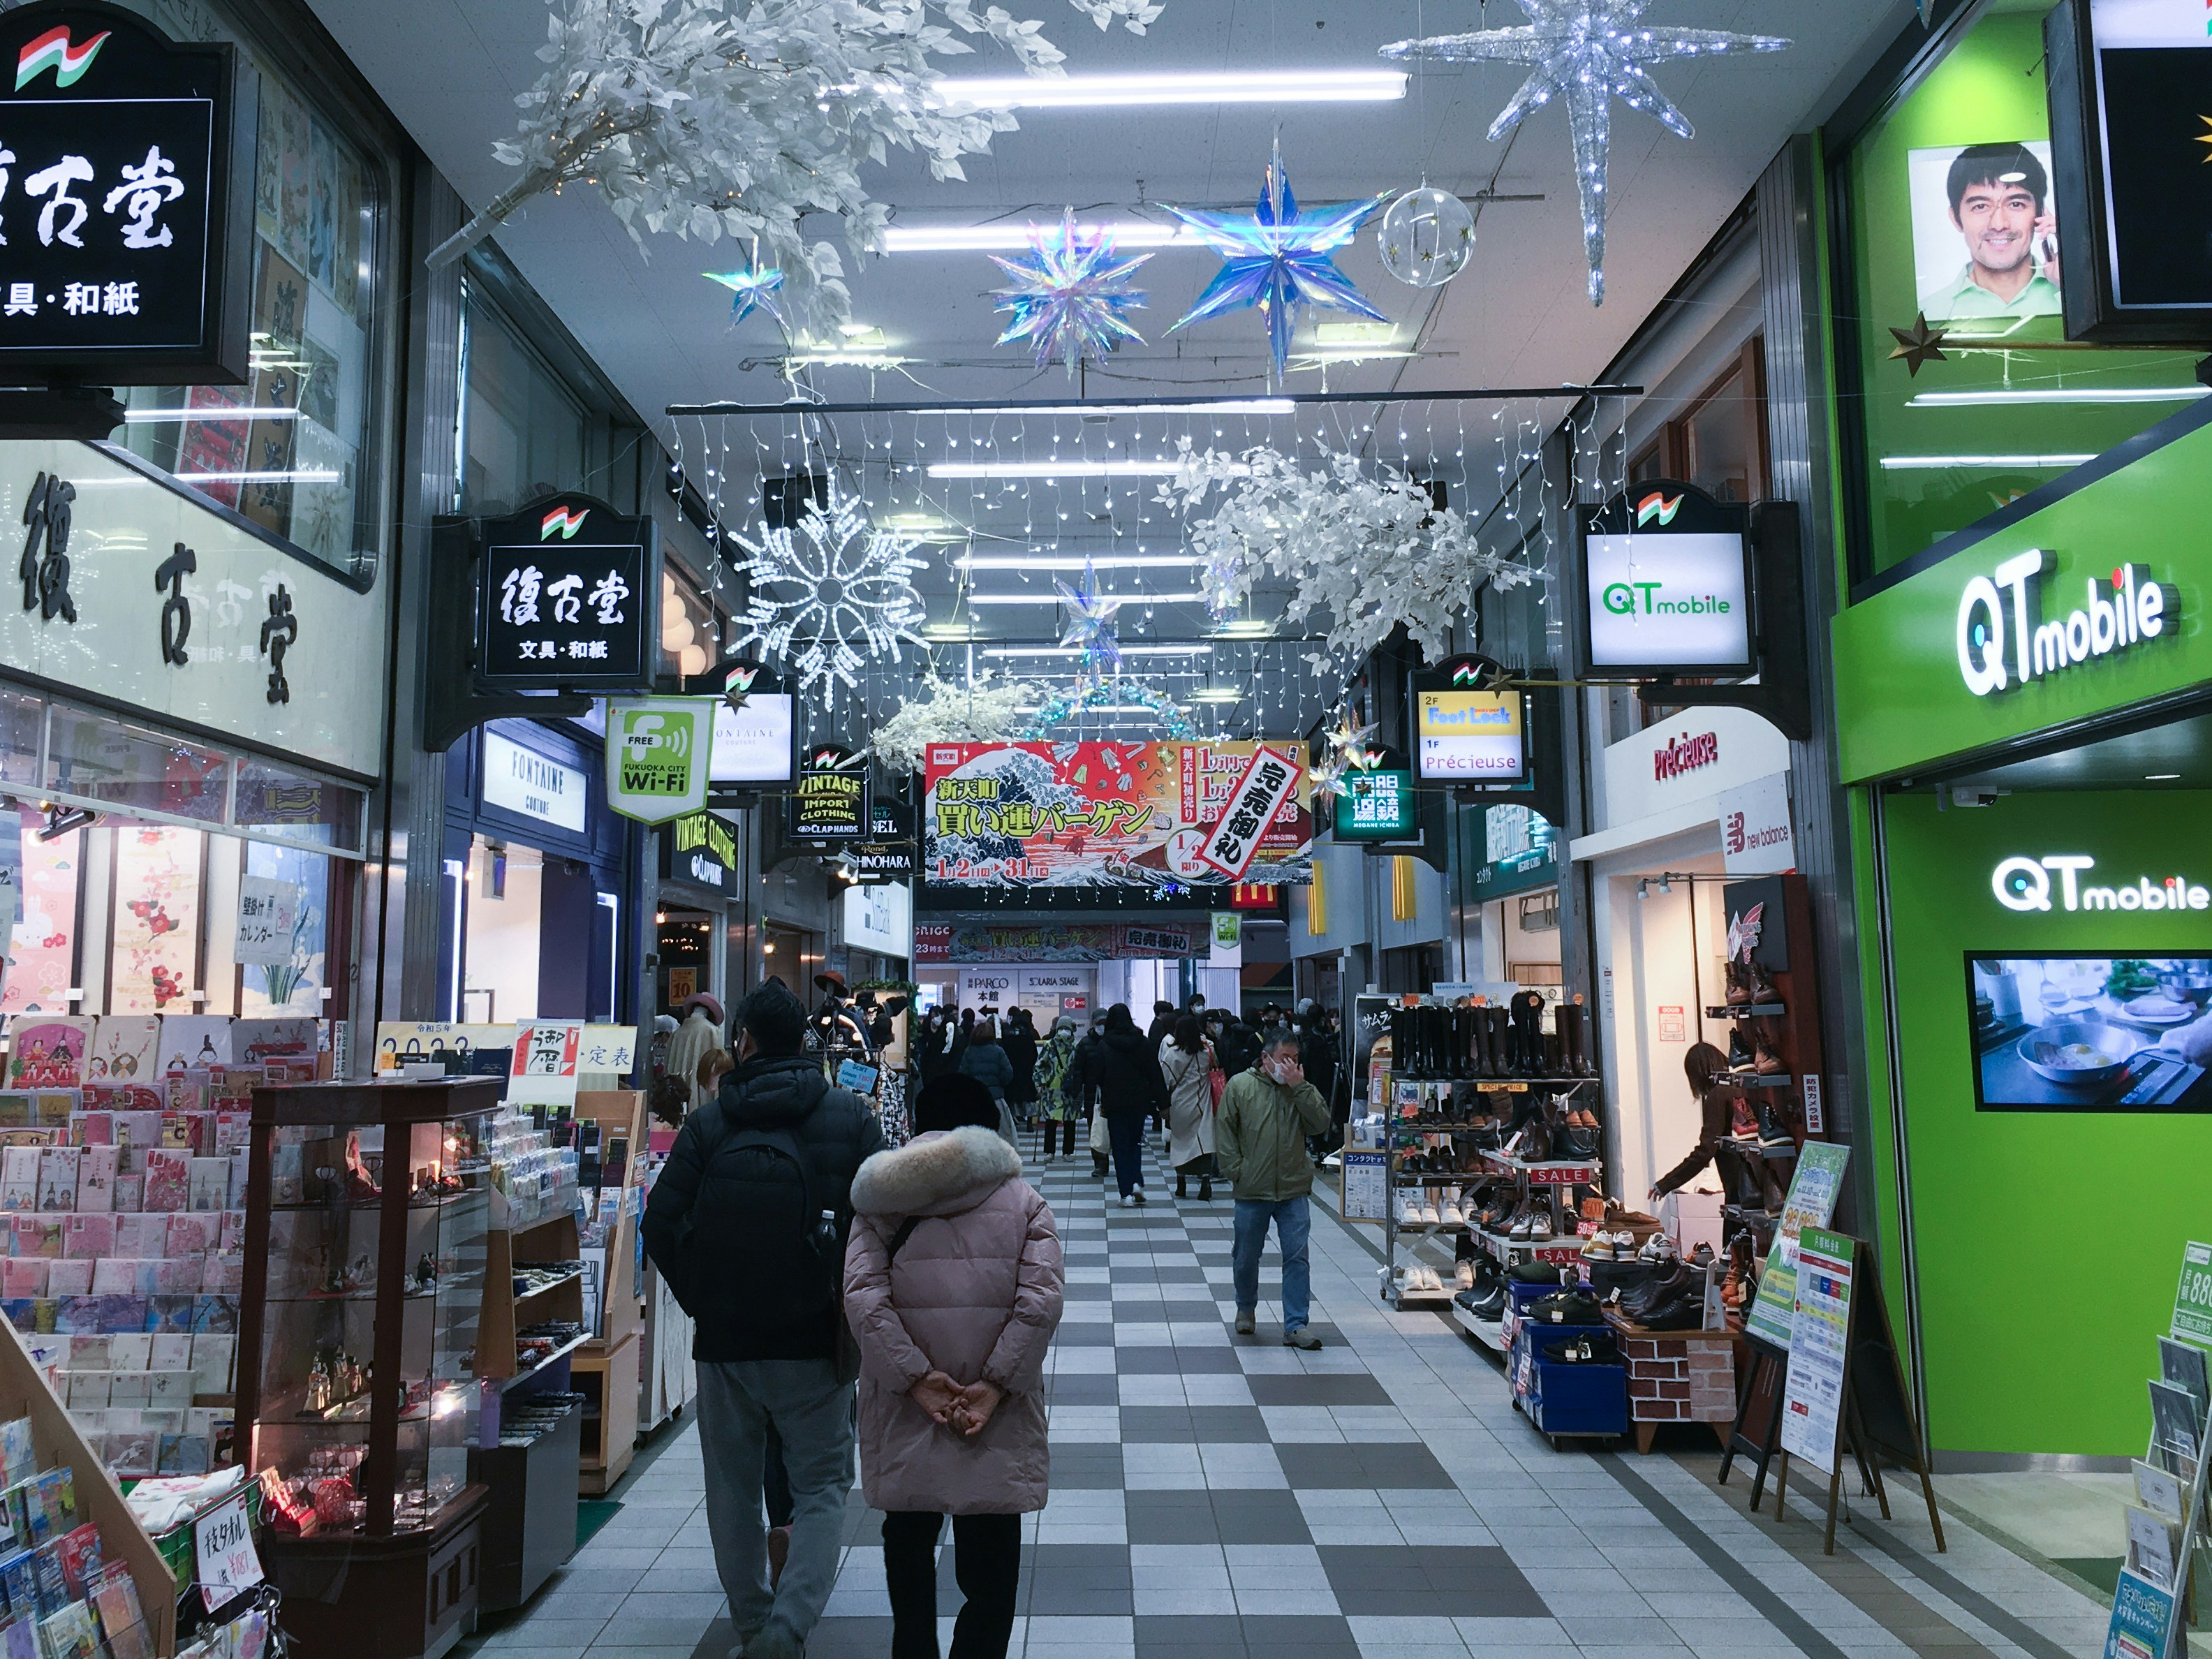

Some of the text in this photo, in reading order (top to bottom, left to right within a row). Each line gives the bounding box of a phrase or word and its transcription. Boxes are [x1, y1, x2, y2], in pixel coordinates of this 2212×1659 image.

[0, 281, 140, 316] 具・和紙
[501, 566, 629, 626] 復古堂
[1602, 582, 1730, 616] QTmobile
[519, 640, 607, 659] 文具・和紙
[1425, 696, 1438, 705] 2F
[1428, 707, 1510, 724] Foot Lock
[628, 737, 654, 745] FREE
[716, 729, 774, 737] ONTAINE
[1427, 740, 1439, 749] 1F
[1426, 755, 1516, 769] Précieuse
[512, 751, 563, 795] FONTAINE
[624, 772, 685, 792] Wi-Fi
[938, 778, 998, 801] 新天町
[1183, 748, 1194, 821] 新天町初売り
[804, 799, 849, 810] IMPORT
[1214, 762, 1287, 864] 完売御礼
[800, 810, 855, 821] CLOTHING
[936, 802, 1153, 837] 買い運バーゲン
[676, 815, 707, 852] VINTAGE
[1747, 825, 1789, 850] new balance
[1991, 855, 2211, 911] QTmobile
[239, 923, 273, 943] カレンダー
[975, 978, 1009, 989] PARCO
[1059, 978, 1079, 986] STAGE
[978, 990, 999, 1002] 本館
[417, 1024, 452, 1033] 令和5年
[1538, 1170, 1583, 1181] SALE
[1544, 1250, 1577, 1262] SAL
